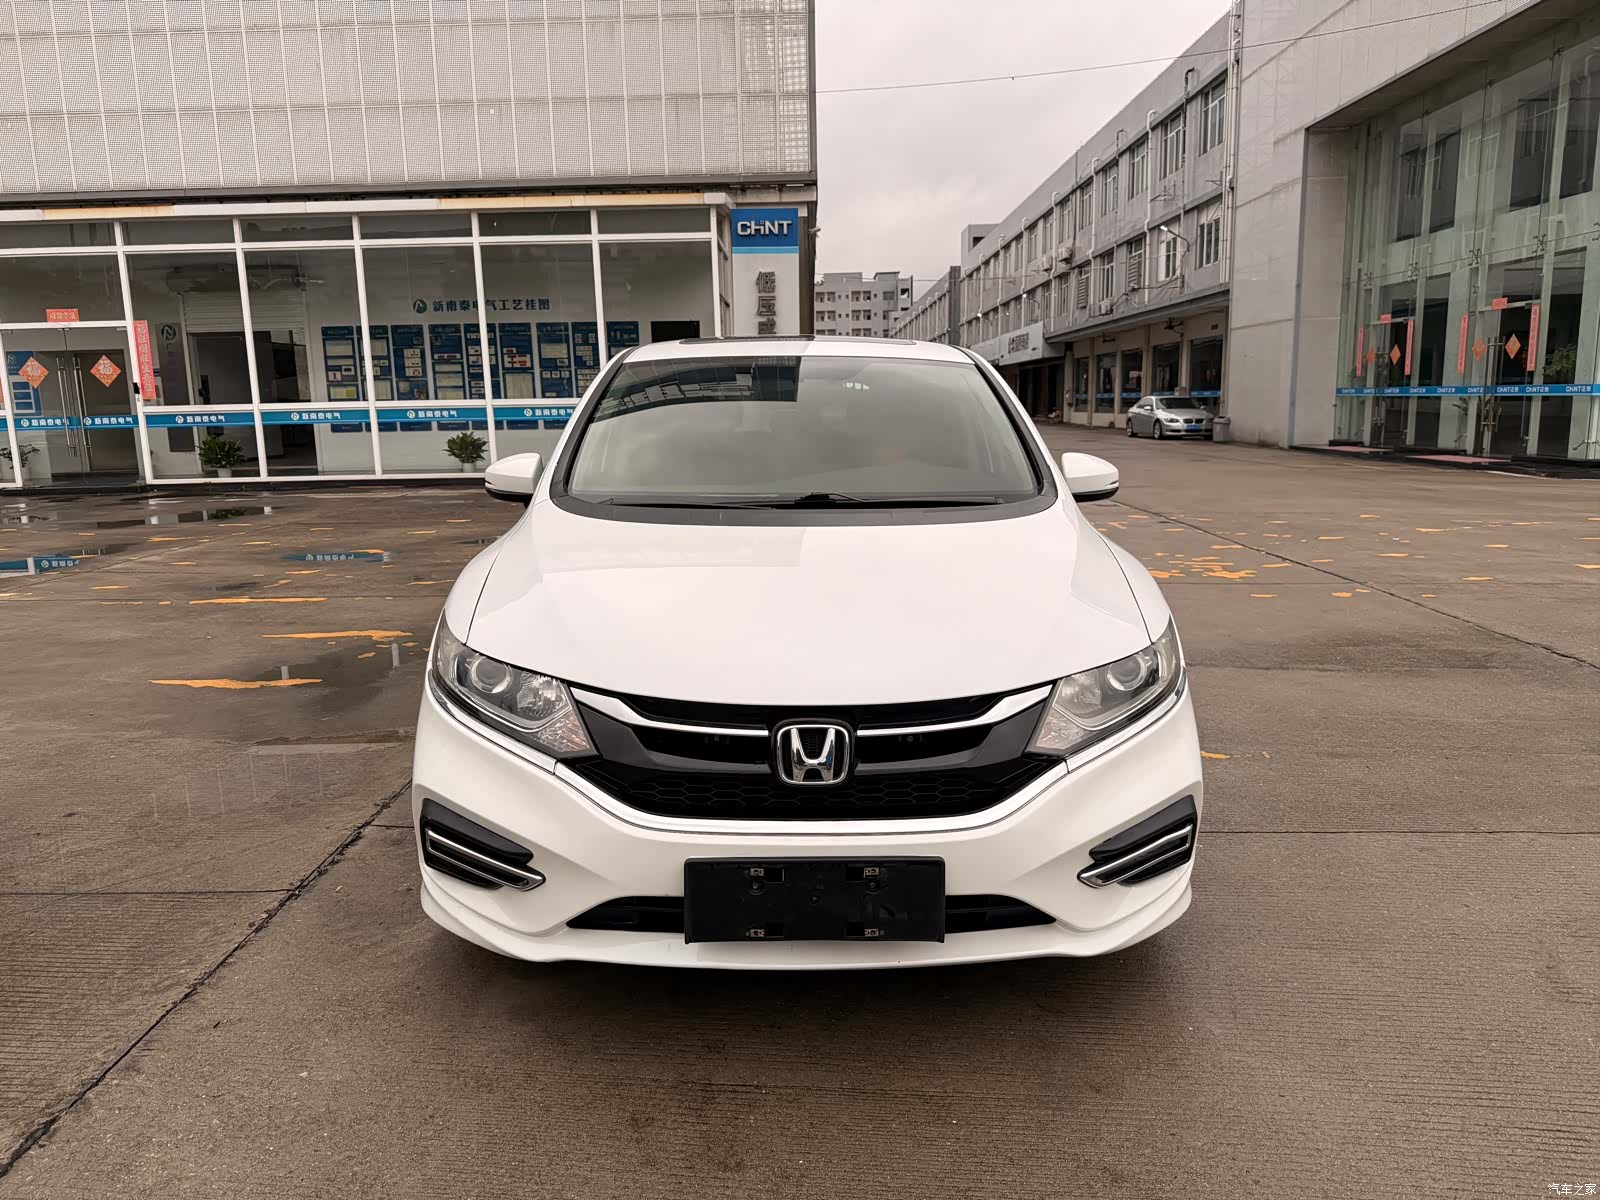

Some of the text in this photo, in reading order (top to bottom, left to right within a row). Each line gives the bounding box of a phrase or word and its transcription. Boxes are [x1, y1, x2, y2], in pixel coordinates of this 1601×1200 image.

[302, 412, 341, 420] 新南泰电气
[418, 410, 457, 418] 新南泰电气
[186, 415, 225, 423] 新南泰电气
